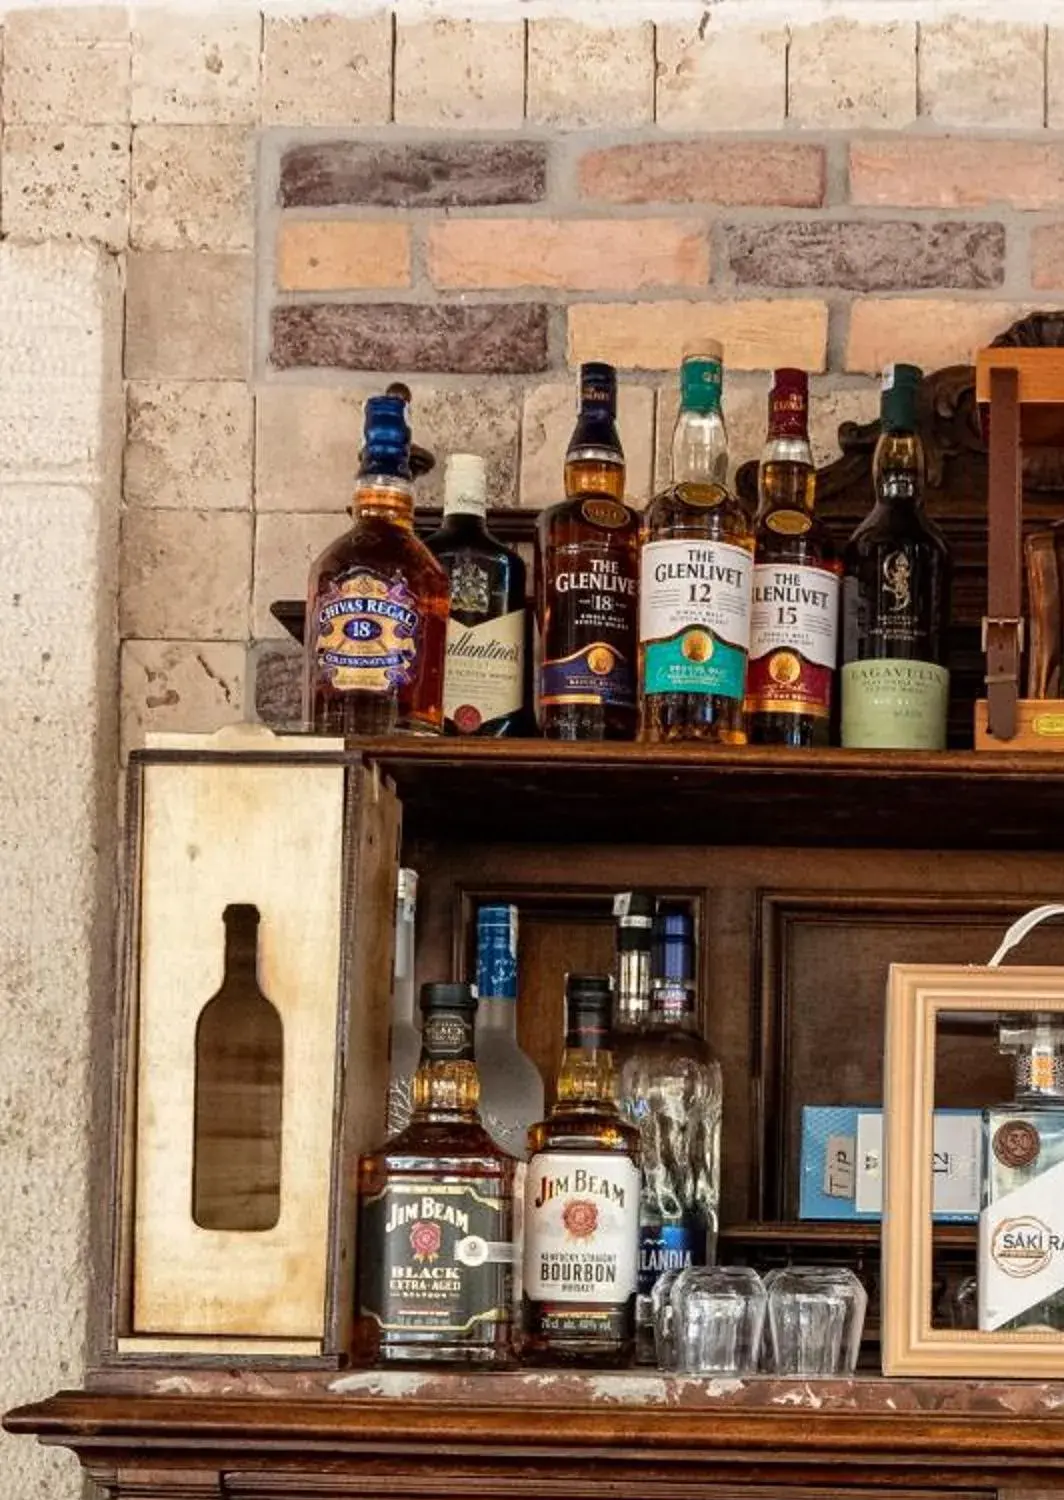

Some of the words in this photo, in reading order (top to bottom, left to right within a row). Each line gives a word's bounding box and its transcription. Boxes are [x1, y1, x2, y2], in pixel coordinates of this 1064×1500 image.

[590, 559, 619, 574] THE
[688, 549, 716, 563] THE
[555, 572, 639, 596] GLENLIVE
[655, 563, 744, 589] GLENLIVET
[774, 573, 802, 587] THE
[592, 595, 613, 611] 18
[688, 583, 712, 603] 12
[751, 586, 830, 611] LENLIVET
[320, 598, 364, 623] CHIVAS
[366, 599, 414, 627] REGAL
[776, 606, 798, 625] 15
[352, 620, 372, 638] 18
[932, 1151, 949, 1174] 12
[534, 1174, 569, 1208] JIM
[574, 1168, 625, 1209] BEAM
[385, 1202, 419, 1233] JIM
[420, 1196, 469, 1235] BEAM
[638, 1248, 693, 1272] LANDIA
[391, 1267, 462, 1279] BLACK
[540, 1262, 617, 1284] BOURBON
